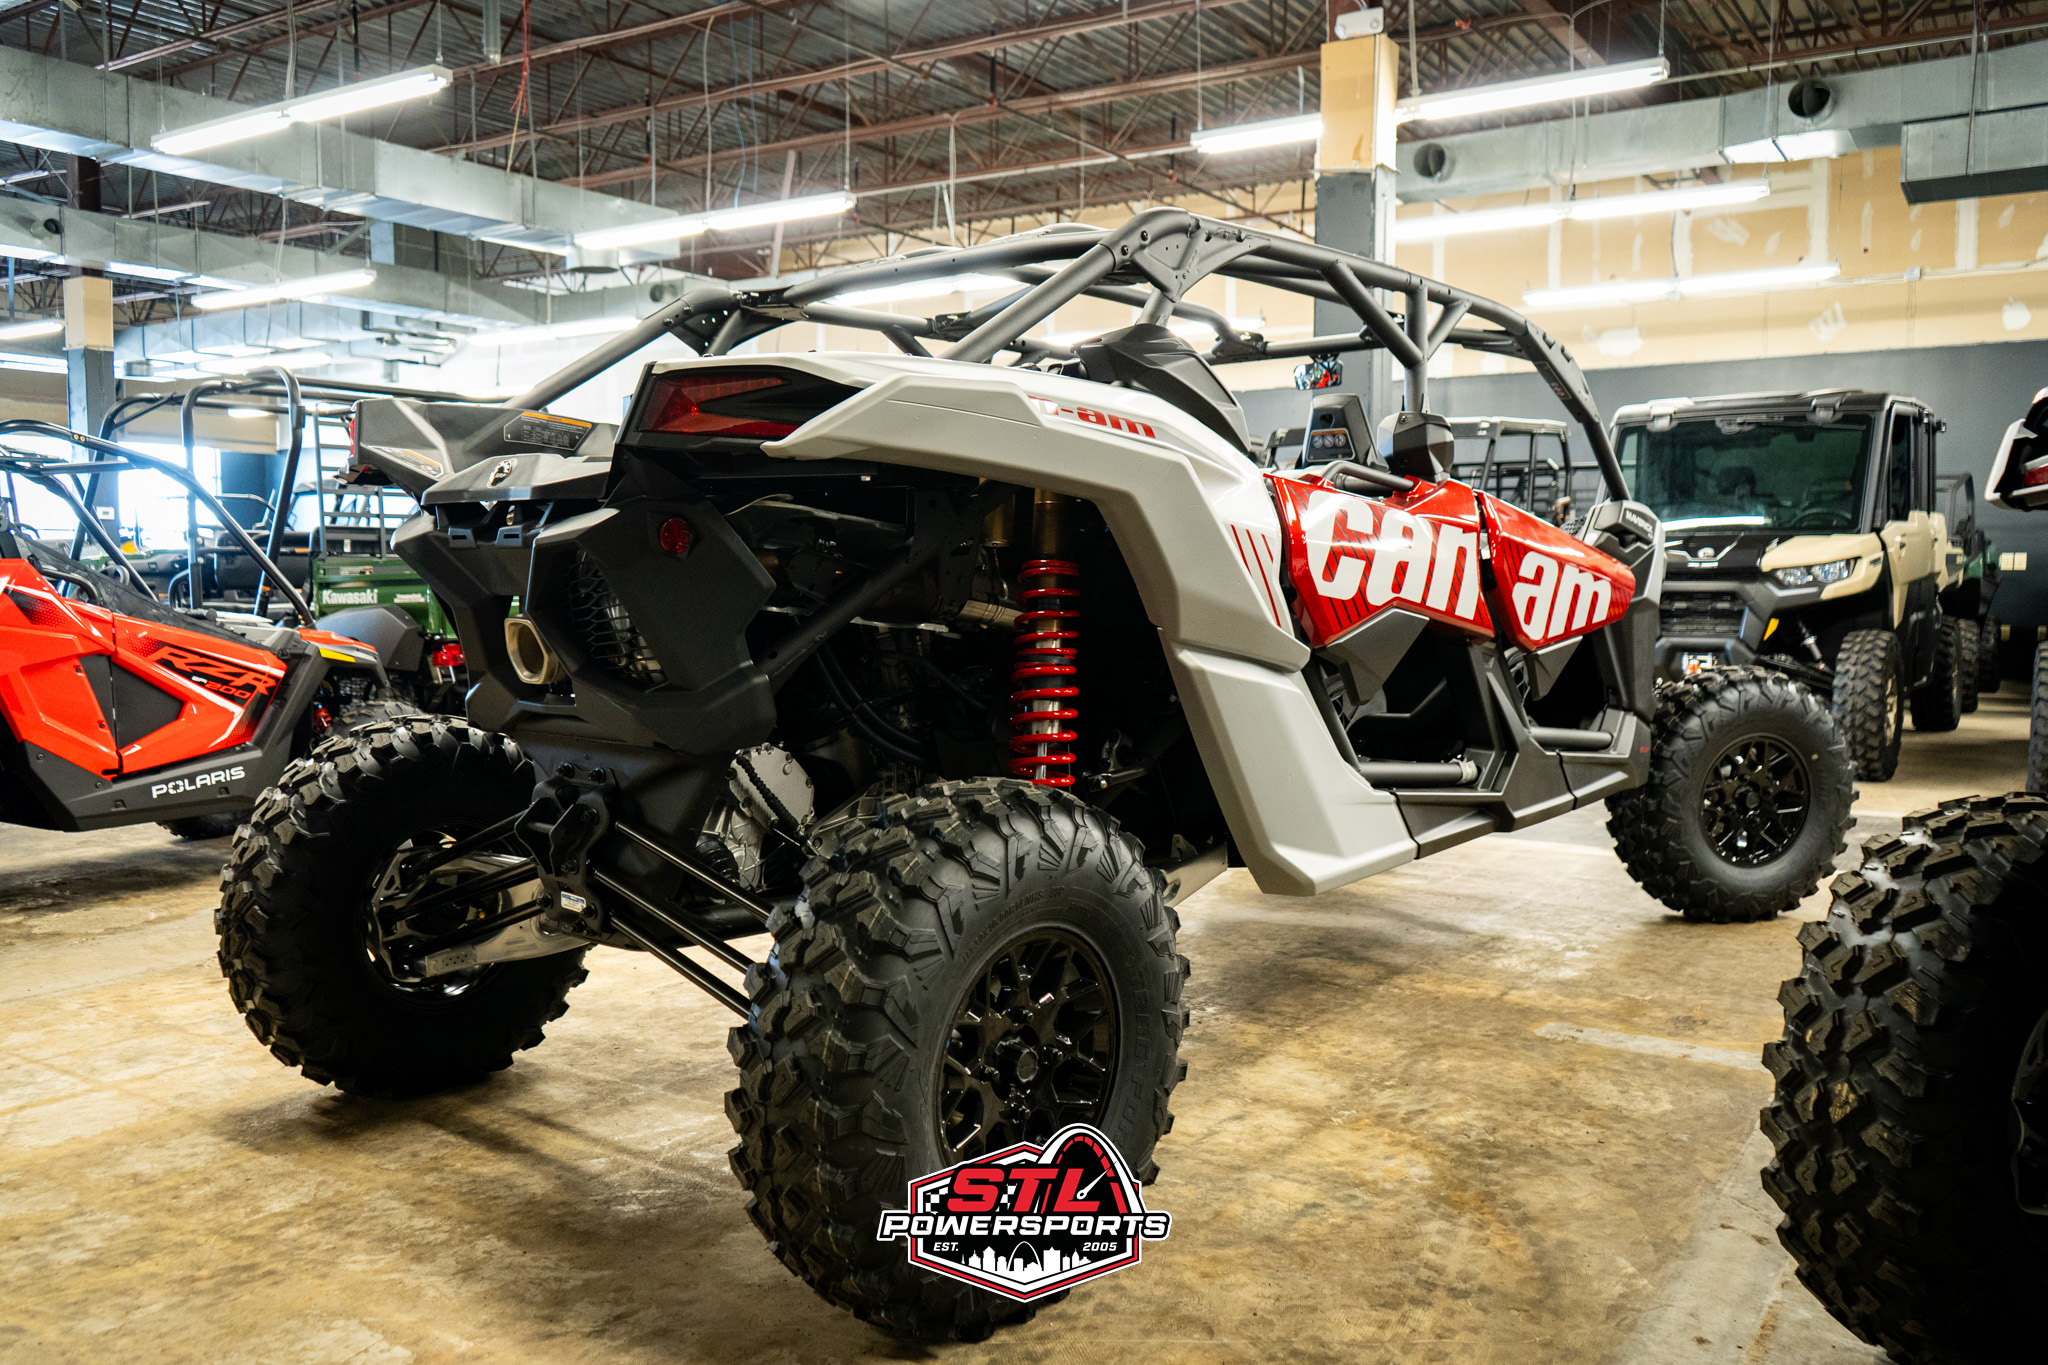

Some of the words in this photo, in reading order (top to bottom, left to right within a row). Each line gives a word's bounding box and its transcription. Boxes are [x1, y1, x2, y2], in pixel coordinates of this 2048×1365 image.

[322, 588, 379, 605] Kawasaki
[1512, 550, 1612, 641] am
[152, 645, 277, 696] RZR
[204, 680, 252, 700] 200
[151, 766, 246, 799] POLARIS
